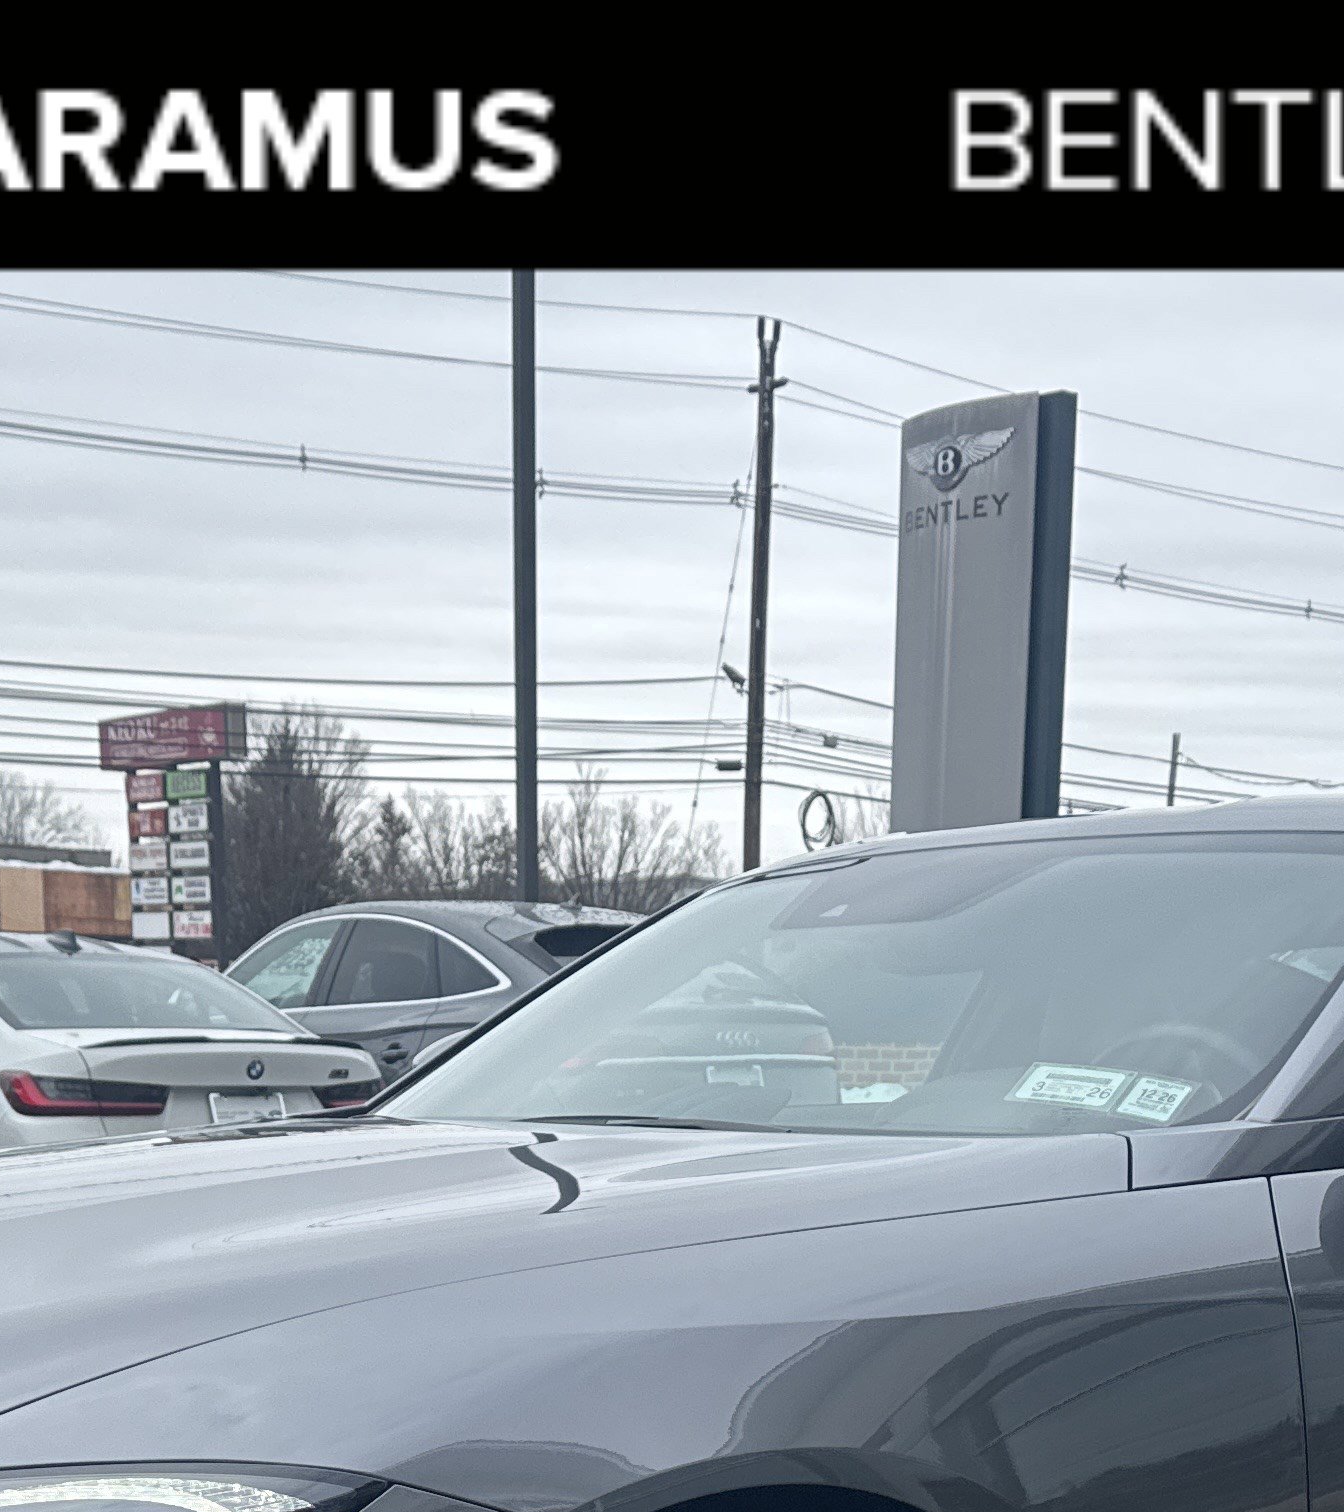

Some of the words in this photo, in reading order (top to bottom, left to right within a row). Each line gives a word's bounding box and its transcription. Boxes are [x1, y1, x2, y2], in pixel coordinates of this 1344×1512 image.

[904, 491, 1010, 534] BENTLEY
[1032, 1081, 1046, 1092] 3
[1086, 1087, 1111, 1099] 26
